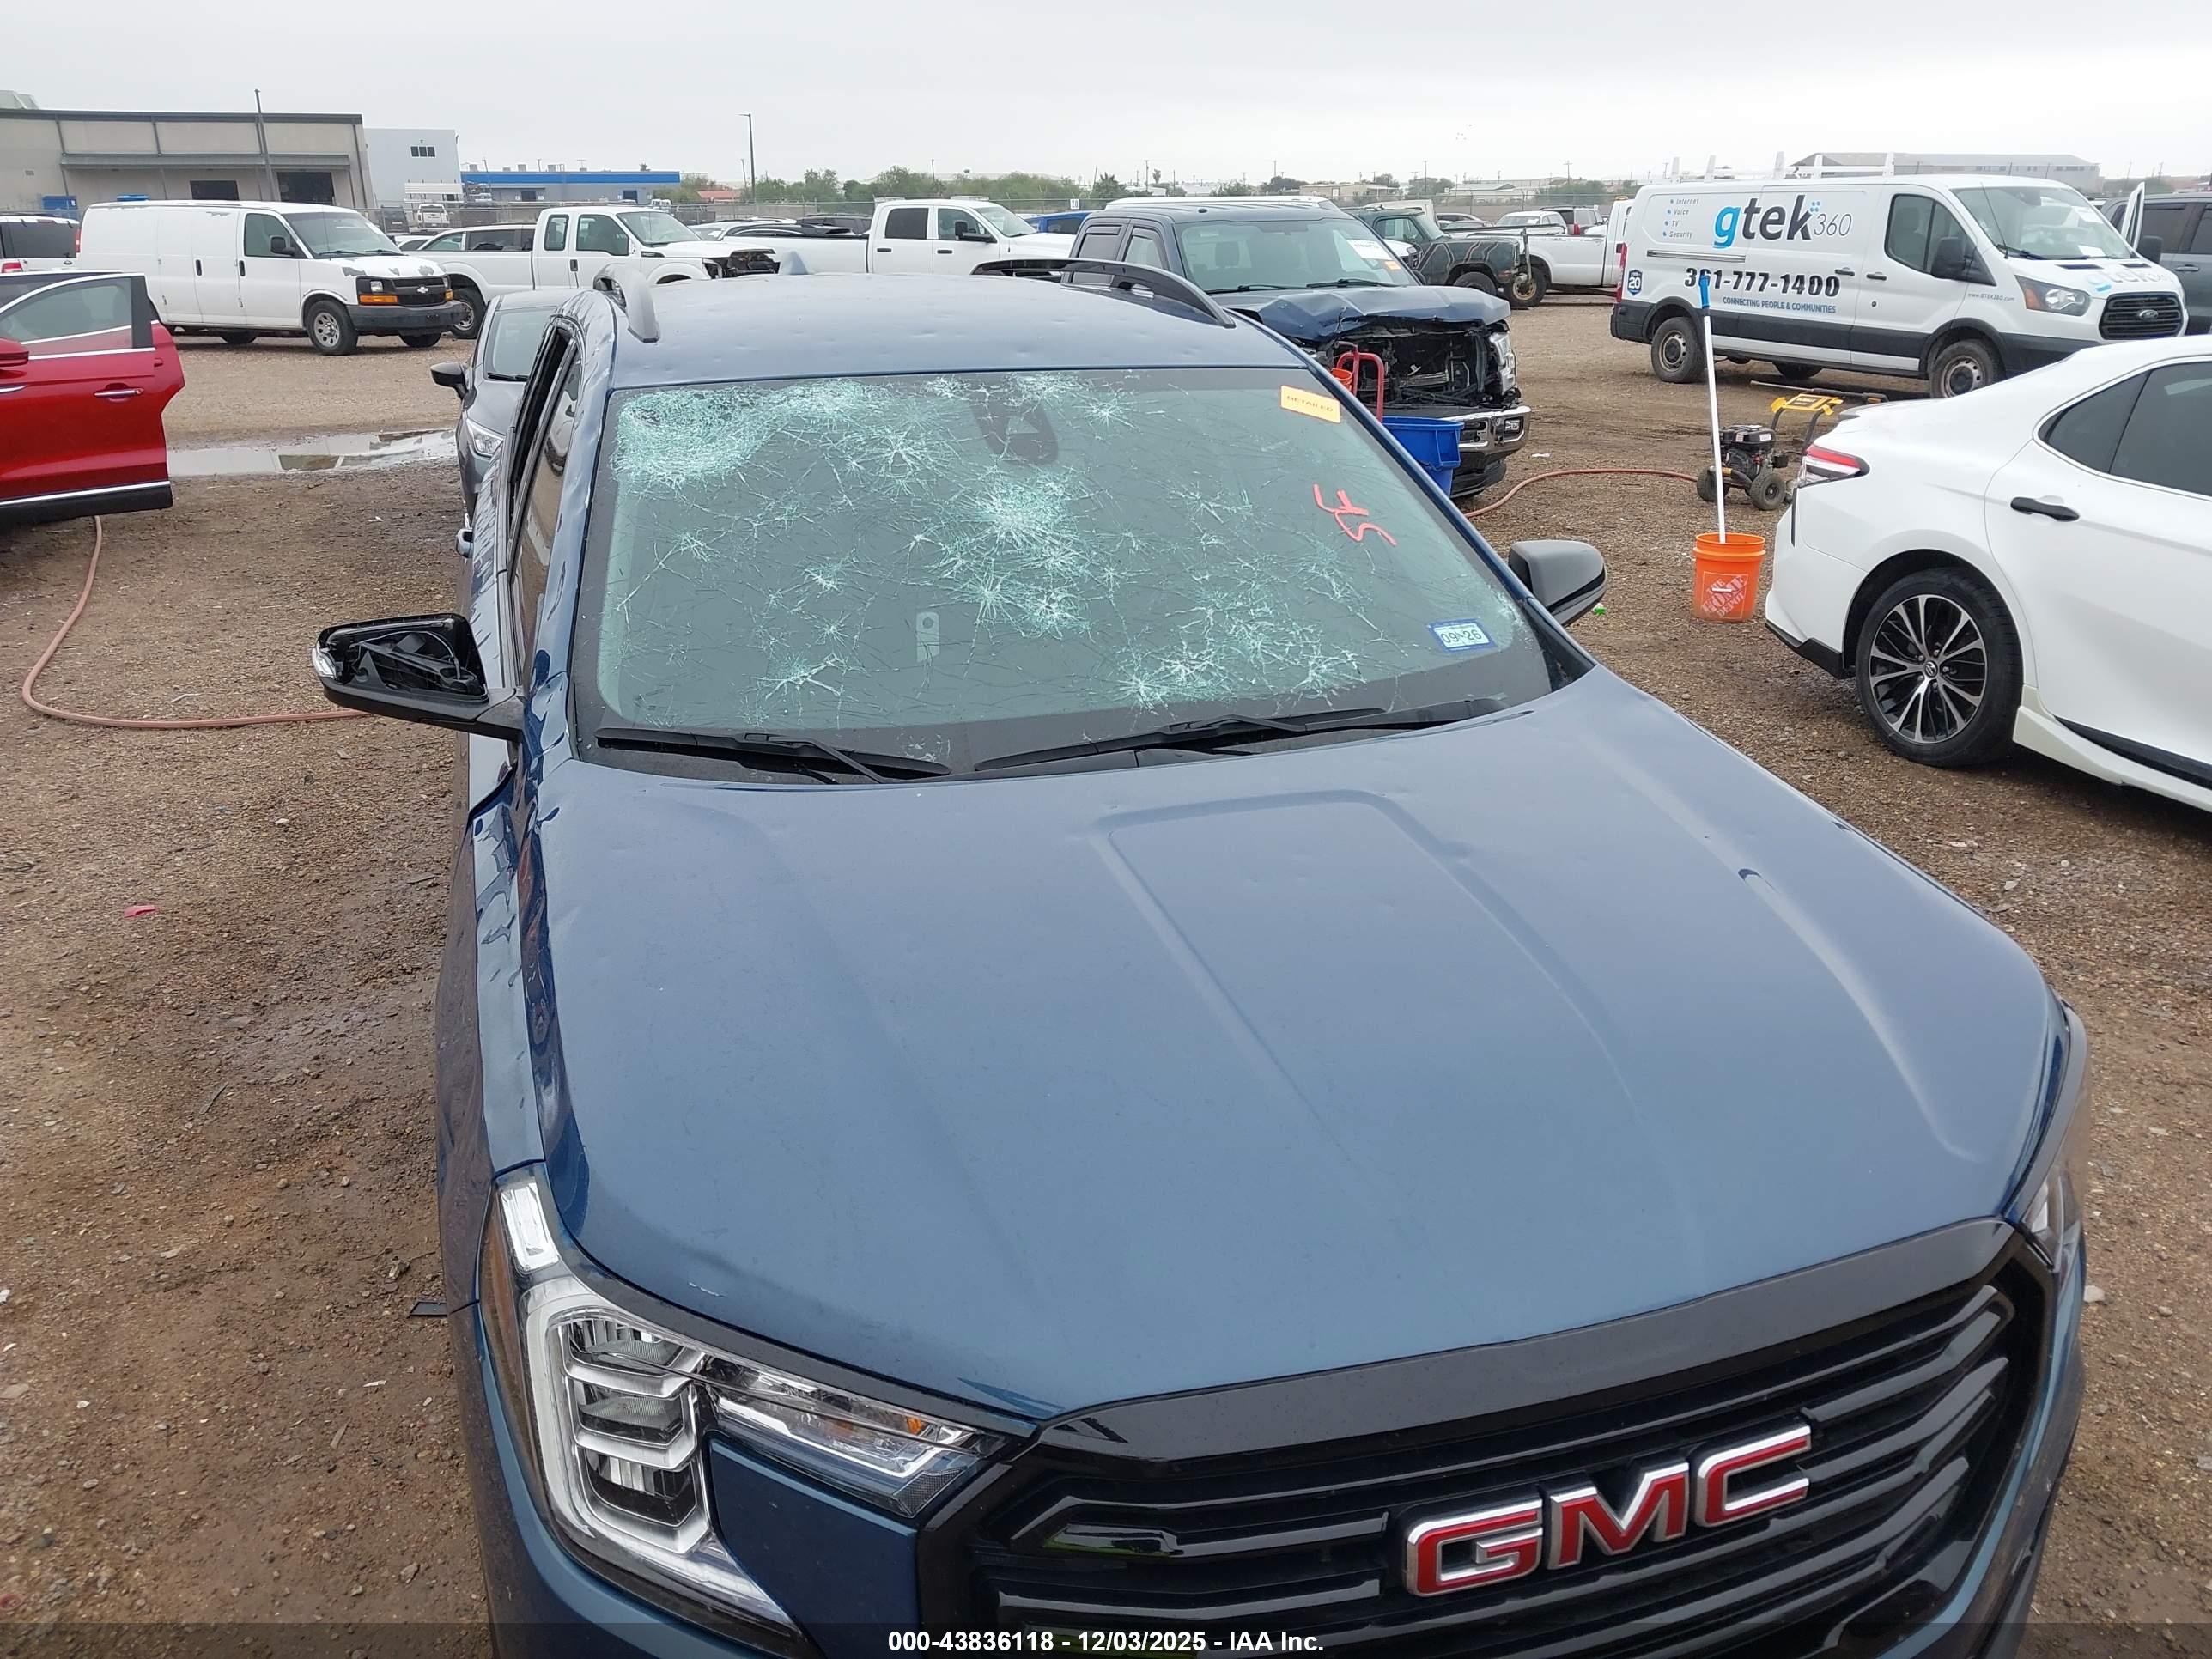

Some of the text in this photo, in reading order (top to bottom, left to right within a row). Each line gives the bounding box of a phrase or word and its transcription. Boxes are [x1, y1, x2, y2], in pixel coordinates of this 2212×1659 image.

[1628, 276, 1641, 289] 20
[1723, 296, 1760, 307] CONNECTING
[1761, 300, 1785, 309] PEOPLE
[1791, 302, 1837, 313] COMMUNITIES
[1407, 1425, 1811, 1597] GMC
